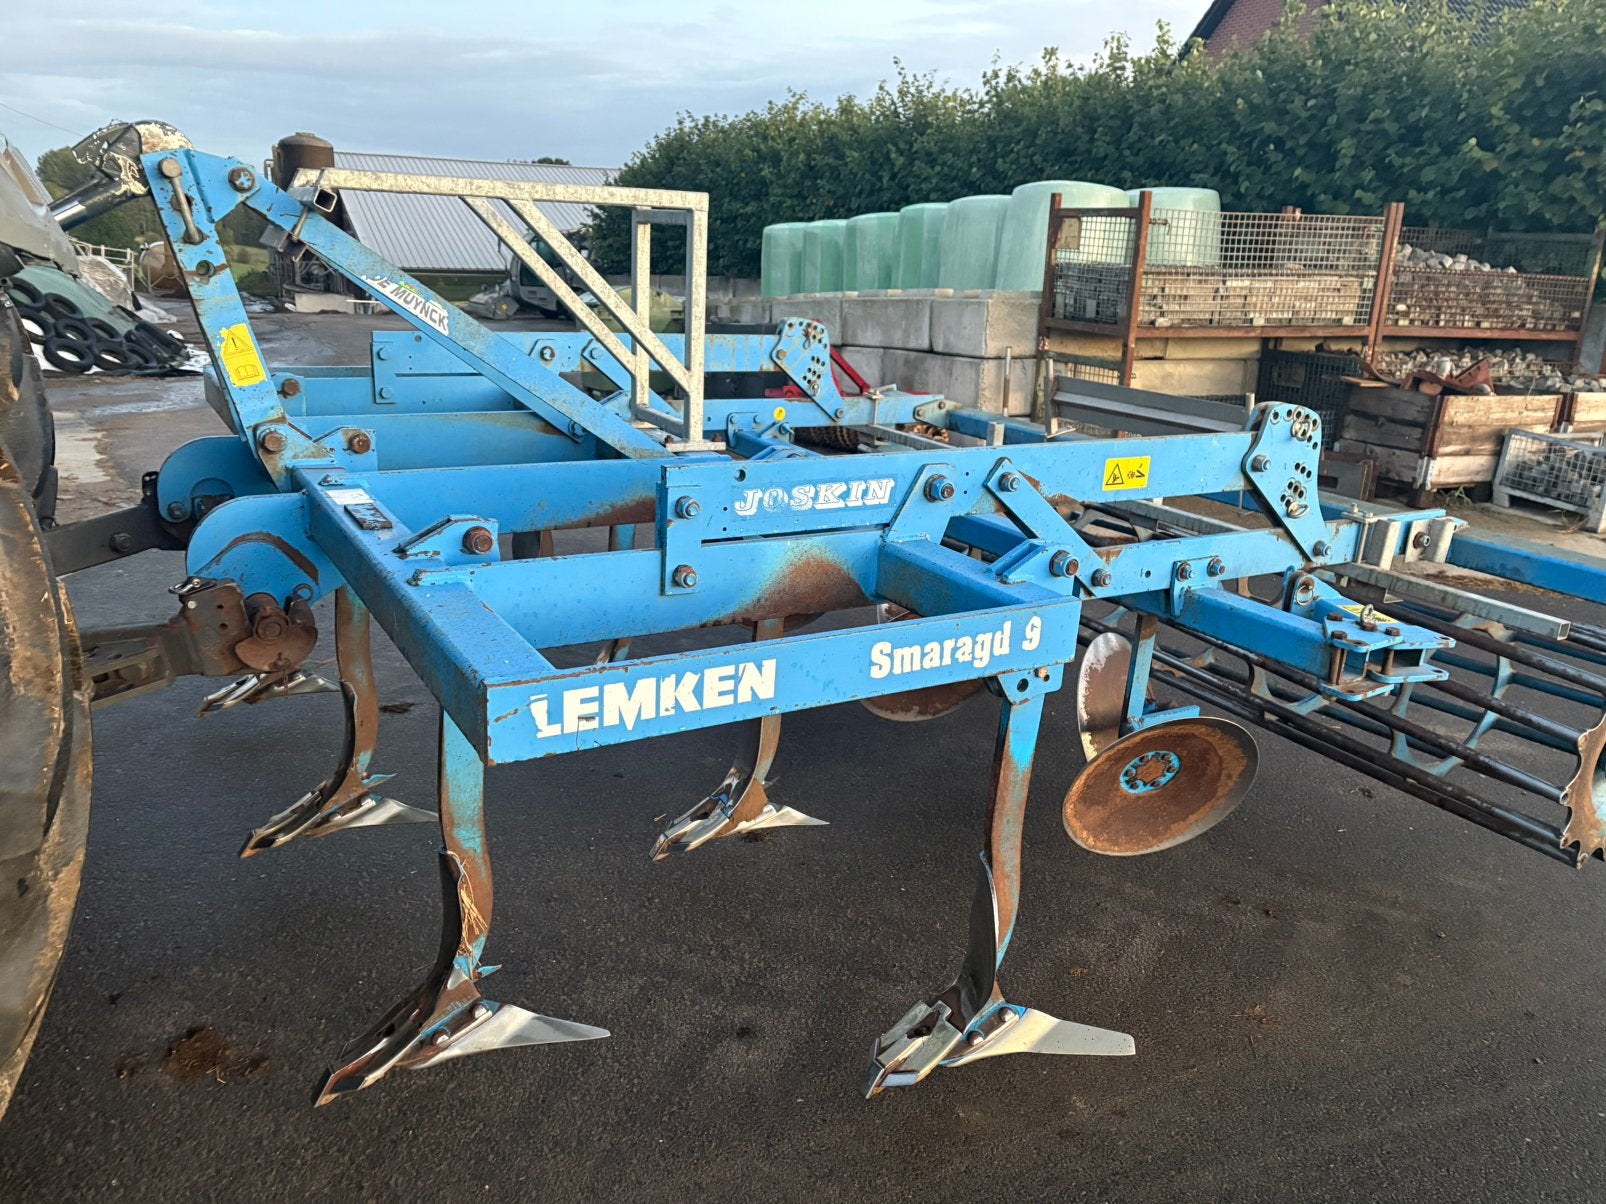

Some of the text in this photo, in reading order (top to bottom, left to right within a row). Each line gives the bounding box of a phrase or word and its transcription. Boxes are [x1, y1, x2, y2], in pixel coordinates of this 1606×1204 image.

[390, 286, 448, 332] MUYNCK
[733, 478, 895, 516] JOSKIN
[870, 615, 1042, 680] Smaragd 9
[529, 658, 777, 739] LEMKEN
